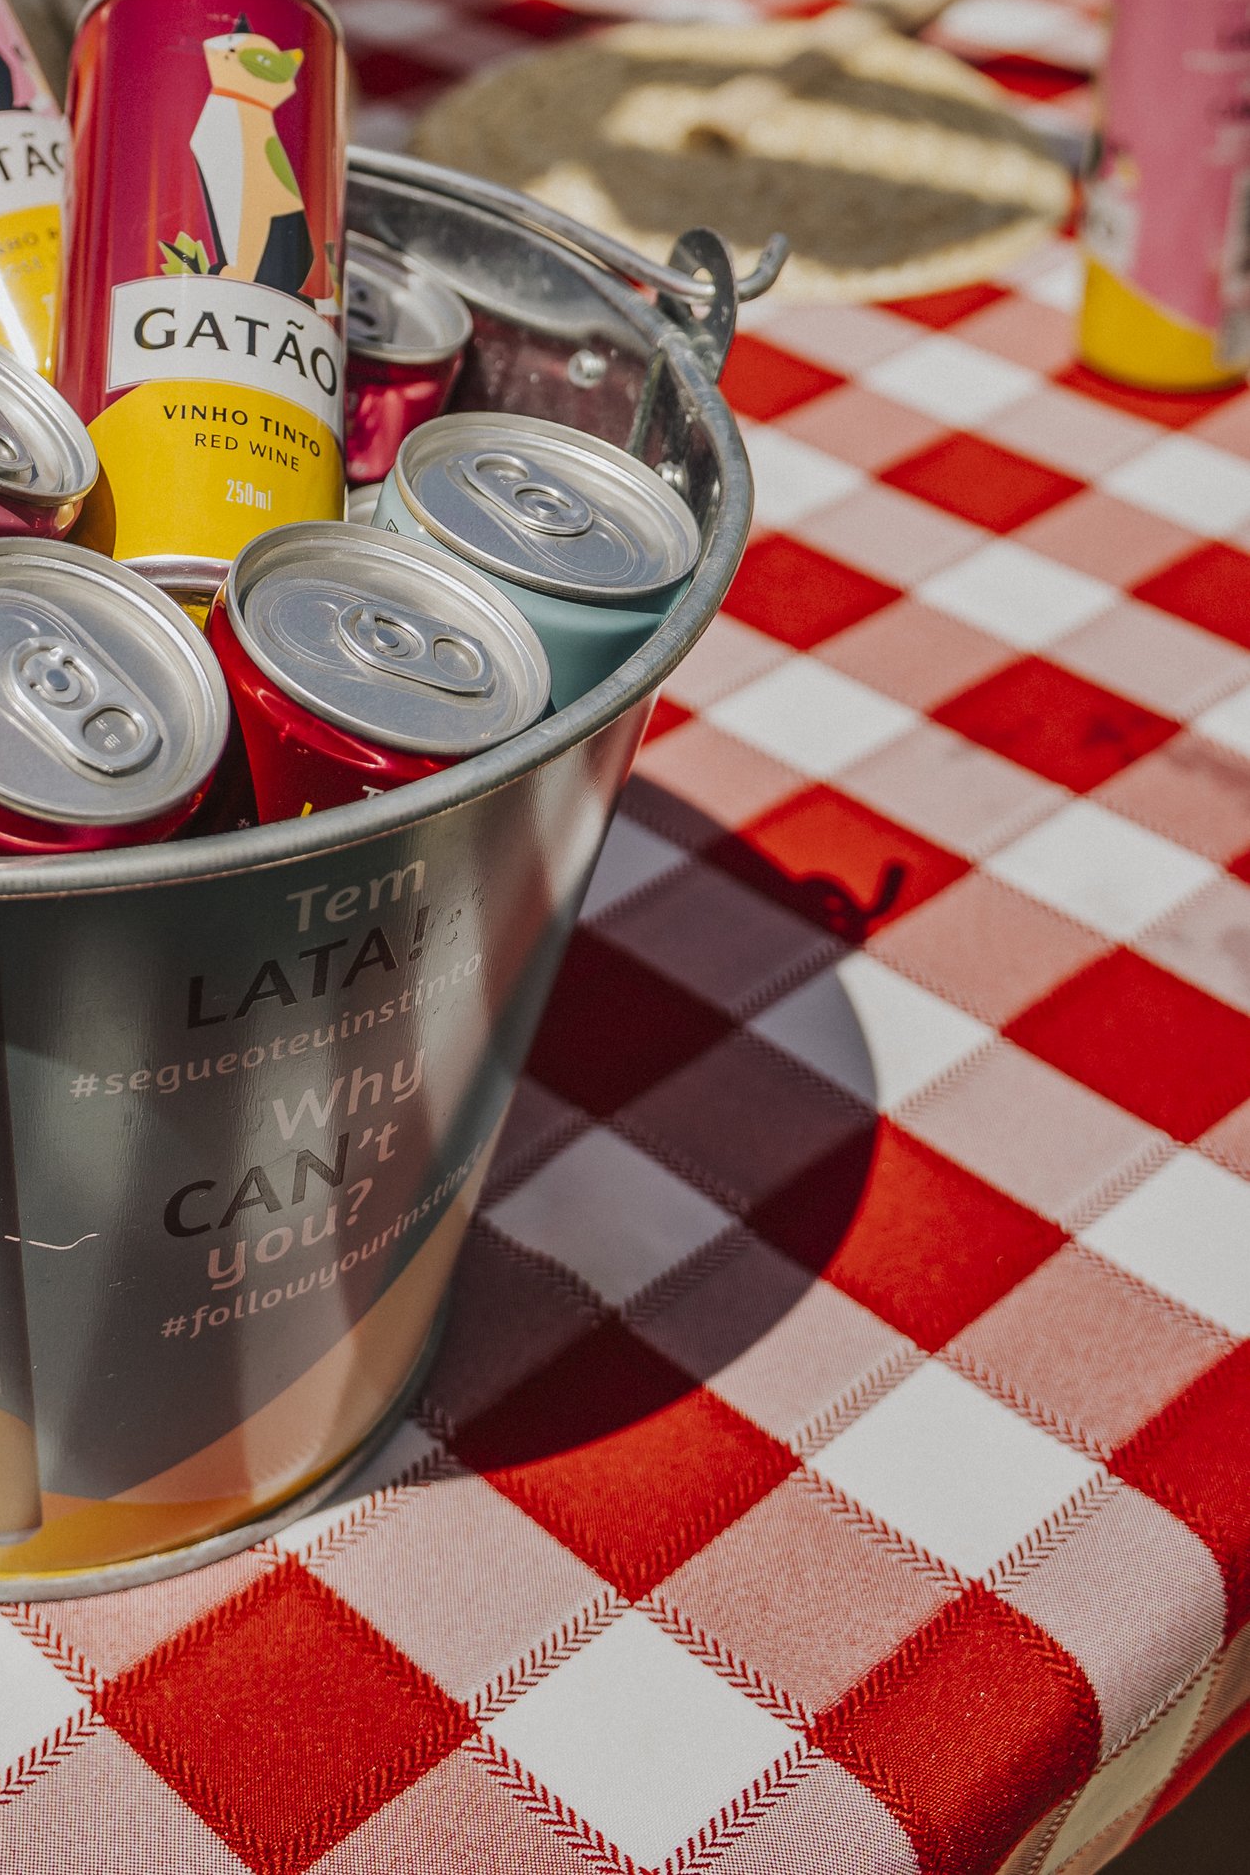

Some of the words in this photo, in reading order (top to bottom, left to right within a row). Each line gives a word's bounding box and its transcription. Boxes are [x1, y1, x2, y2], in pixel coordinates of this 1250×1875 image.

[133, 307, 337, 397] GATÃO
[163, 404, 248, 426] VINHO
[259, 416, 321, 457] TINTO
[194, 433, 239, 451] RED
[249, 440, 299, 472] WINE
[286, 859, 426, 933] Tem
[186, 905, 432, 1029] LATA!
[69, 951, 483, 1099] #segueoteuinstinto
[272, 1046, 426, 1141] Why
[207, 1176, 374, 1291] you?
